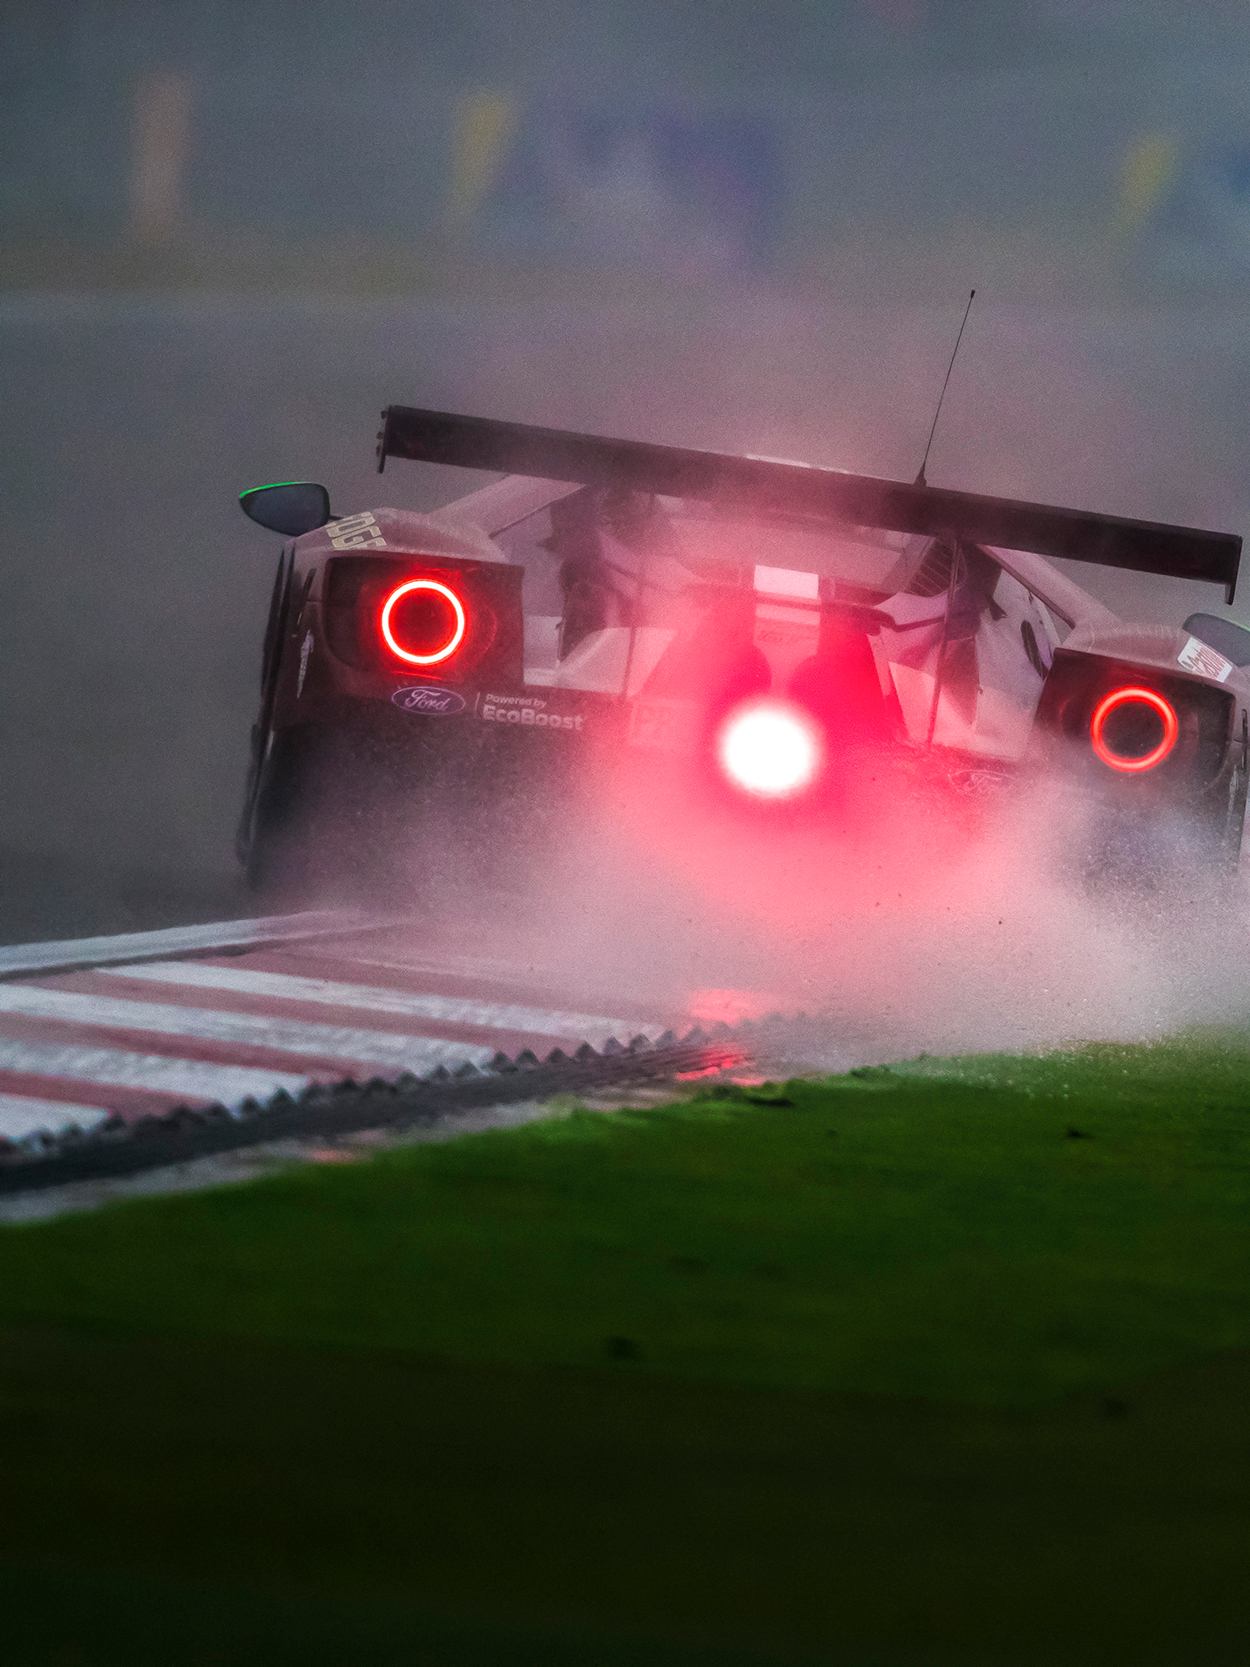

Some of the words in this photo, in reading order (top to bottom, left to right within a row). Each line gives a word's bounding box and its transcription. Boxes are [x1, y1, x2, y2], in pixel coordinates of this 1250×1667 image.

[404, 688, 451, 712] Ford
[486, 693, 532, 707] Powered
[533, 697, 547, 709] by
[482, 704, 584, 731] EcoBoost
